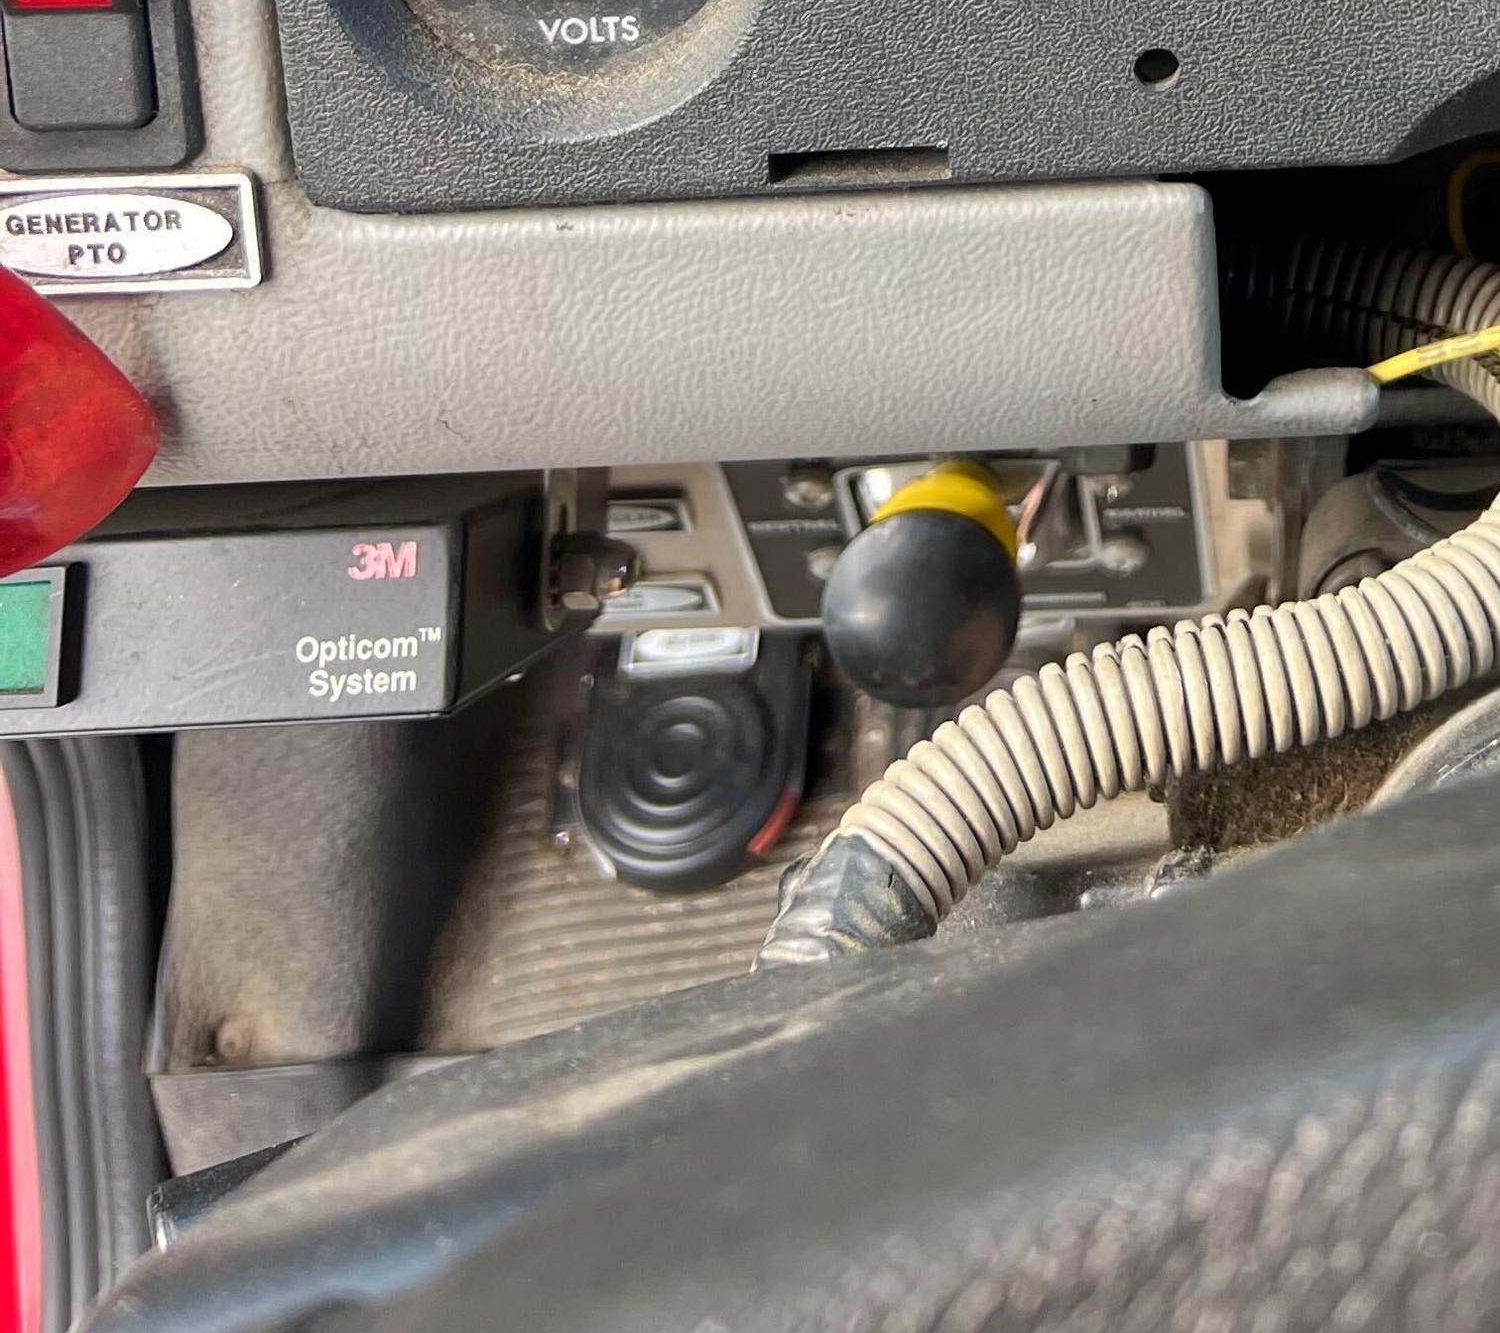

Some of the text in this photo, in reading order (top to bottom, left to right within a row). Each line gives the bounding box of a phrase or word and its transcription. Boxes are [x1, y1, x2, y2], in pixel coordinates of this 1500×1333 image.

[538, 16, 640, 45] VOLTS
[5, 209, 182, 234] GENERATOR
[67, 244, 126, 266] PTO
[347, 541, 417, 580] 3M
[309, 670, 417, 702] System
